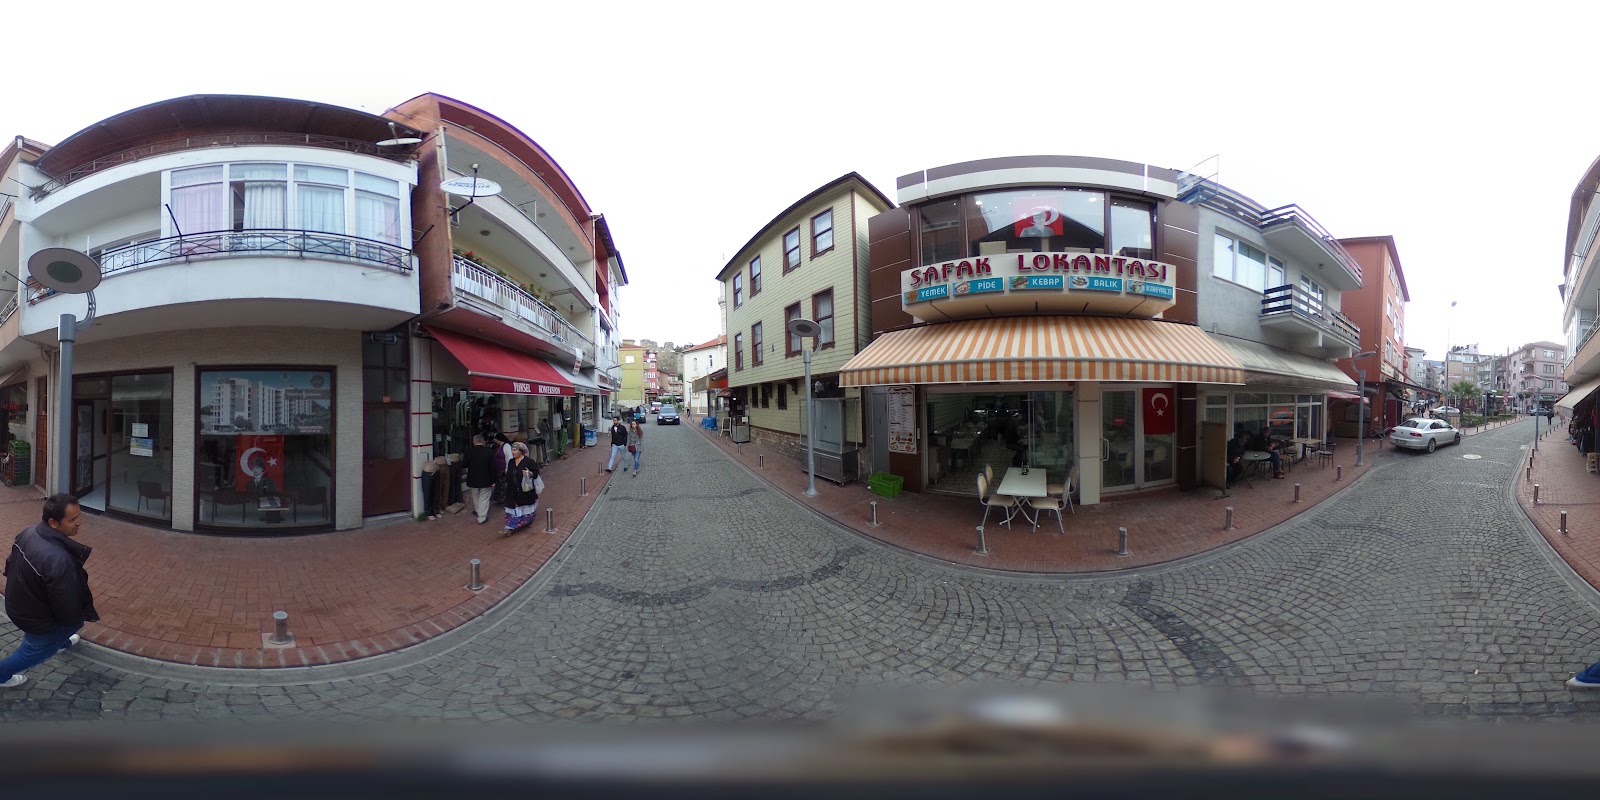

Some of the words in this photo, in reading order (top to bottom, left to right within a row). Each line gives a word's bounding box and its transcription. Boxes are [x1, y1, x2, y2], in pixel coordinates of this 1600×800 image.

[1017, 253, 1167, 282] LOKANTASI
[978, 280, 996, 290] PİDE
[1032, 278, 1060, 286] KEBAP
[1093, 279, 1118, 288] BALIK
[921, 286, 946, 298] YEMEK
